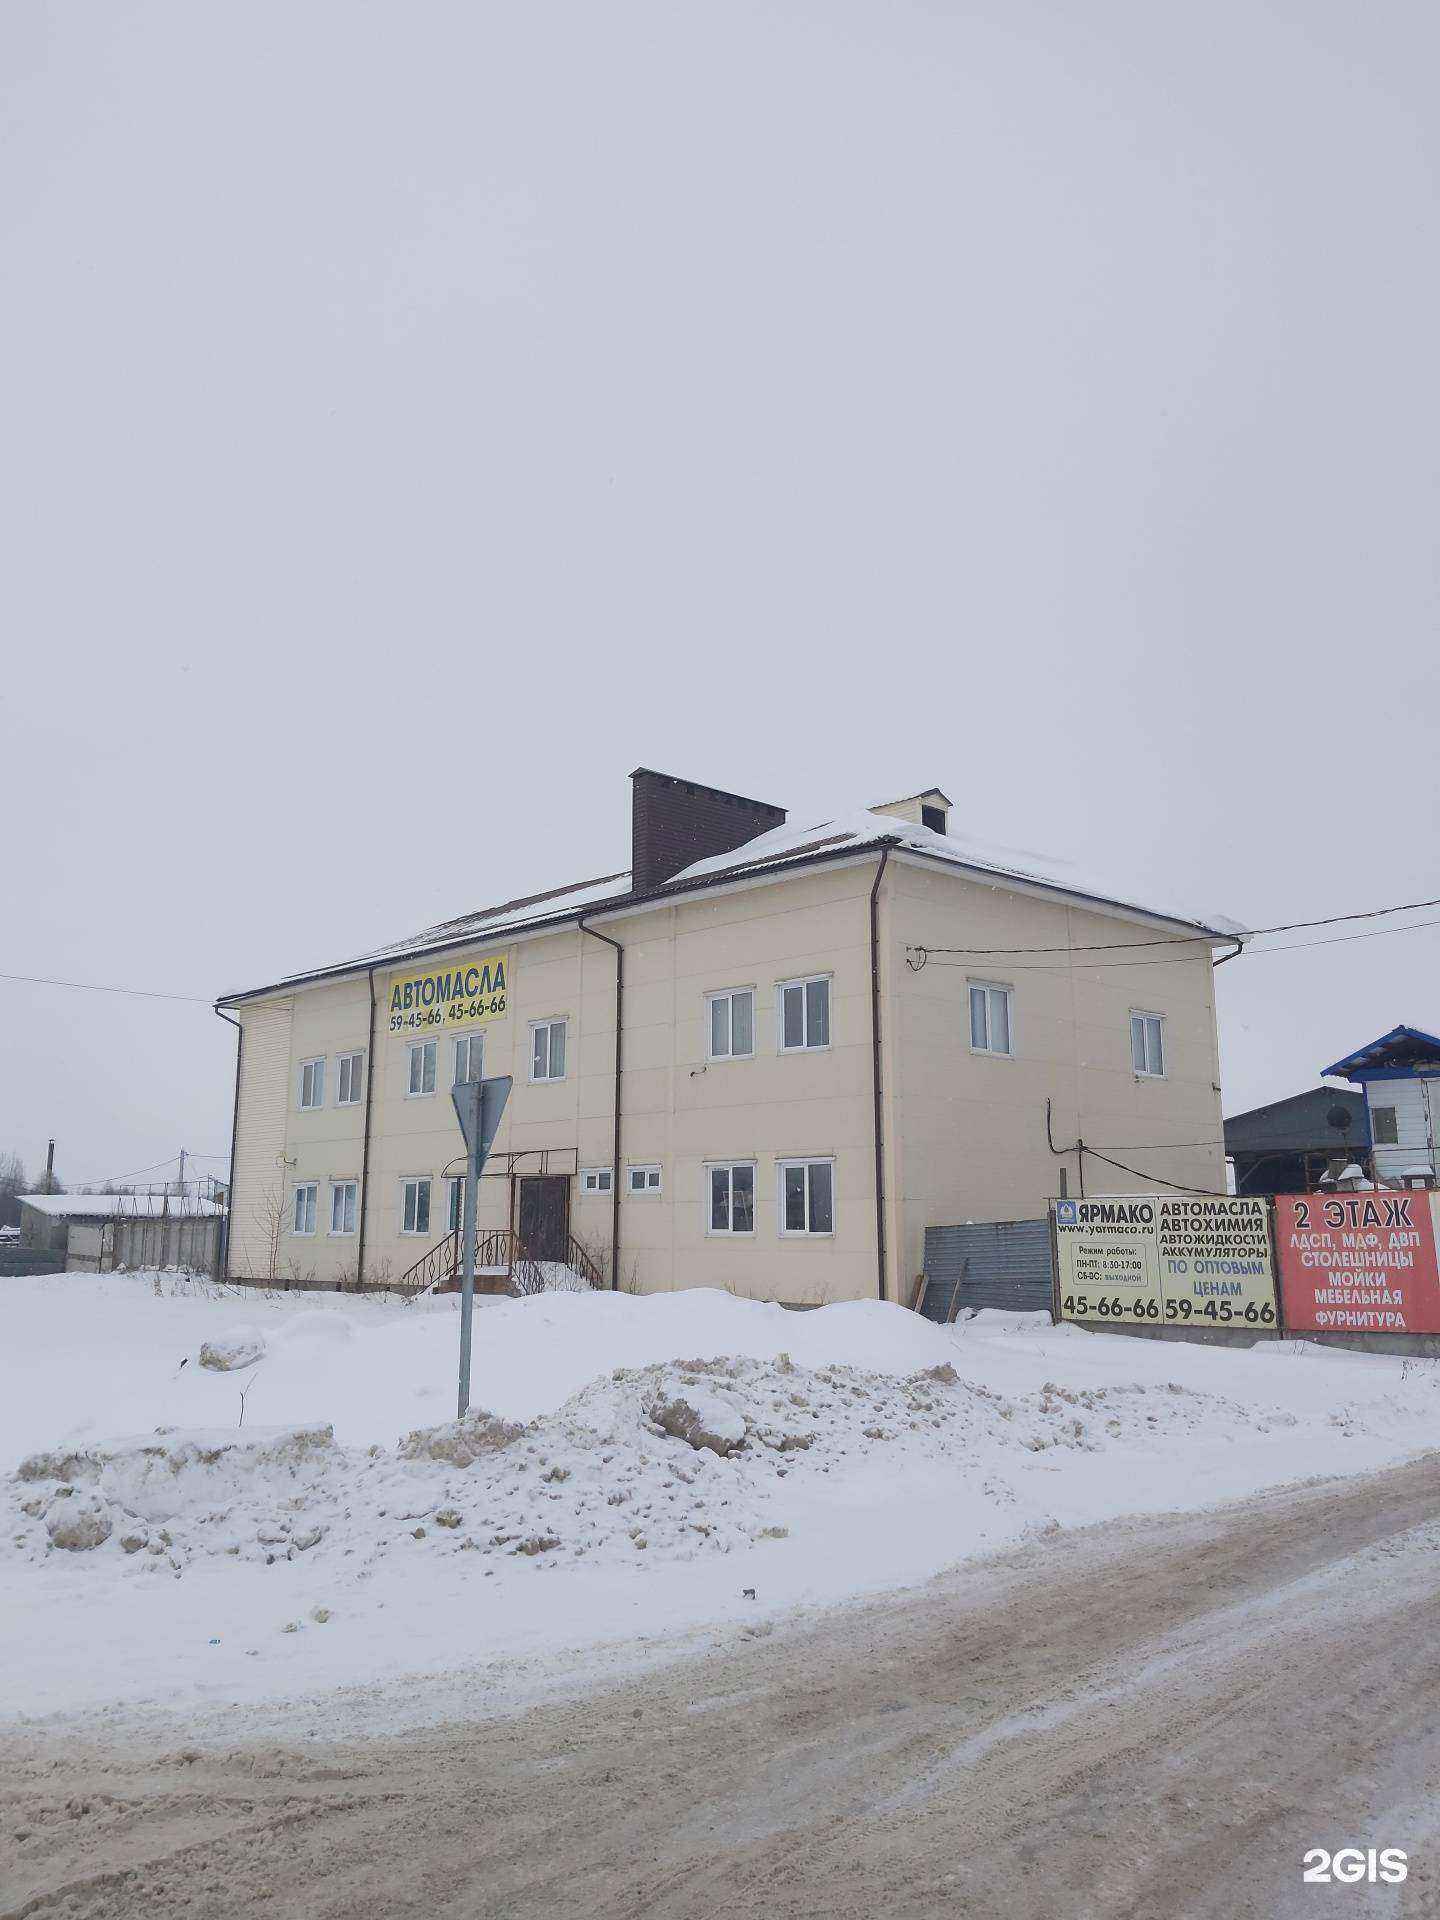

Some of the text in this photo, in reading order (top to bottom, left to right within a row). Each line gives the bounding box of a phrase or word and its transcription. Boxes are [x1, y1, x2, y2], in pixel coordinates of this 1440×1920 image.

[391, 961, 506, 1012] АВТОМАСЛА
[389, 995, 506, 1031] 59-45-66, 45-66-66
[1079, 1204, 1154, 1224] ЯРМАКО
[1160, 1202, 1263, 1216] АВТОМАСЛА
[1294, 1198, 1415, 1230] 2 ЭТАЖ
[1058, 1224, 1154, 1235] www.yarmaco.ru
[1160, 1218, 1263, 1232] АВТОХИМИЯ
[1160, 1234, 1267, 1246] АВТОЖИДКОСТИ
[1290, 1231, 1421, 1250] ЛДСП, МДФ, ДВП
[1079, 1246, 1104, 1255] Режим
[1162, 1246, 1268, 1258] АККУМУЛЯТОРЫ
[1168, 1259, 1265, 1275] ПО ОПТОВЫМ
[1301, 1251, 1414, 1269] СТОЛЕШНИЦЫ
[1328, 1267, 1386, 1287] МОЙКИ
[1193, 1280, 1243, 1297] ЦЕНАМ
[1314, 1288, 1402, 1305] МЕБЕЛЬНАЯ
[1063, 1295, 1159, 1318] 45-66-66
[1165, 1299, 1275, 1323] 59-45-66
[1315, 1310, 1406, 1328] ФУРНИТУРА
